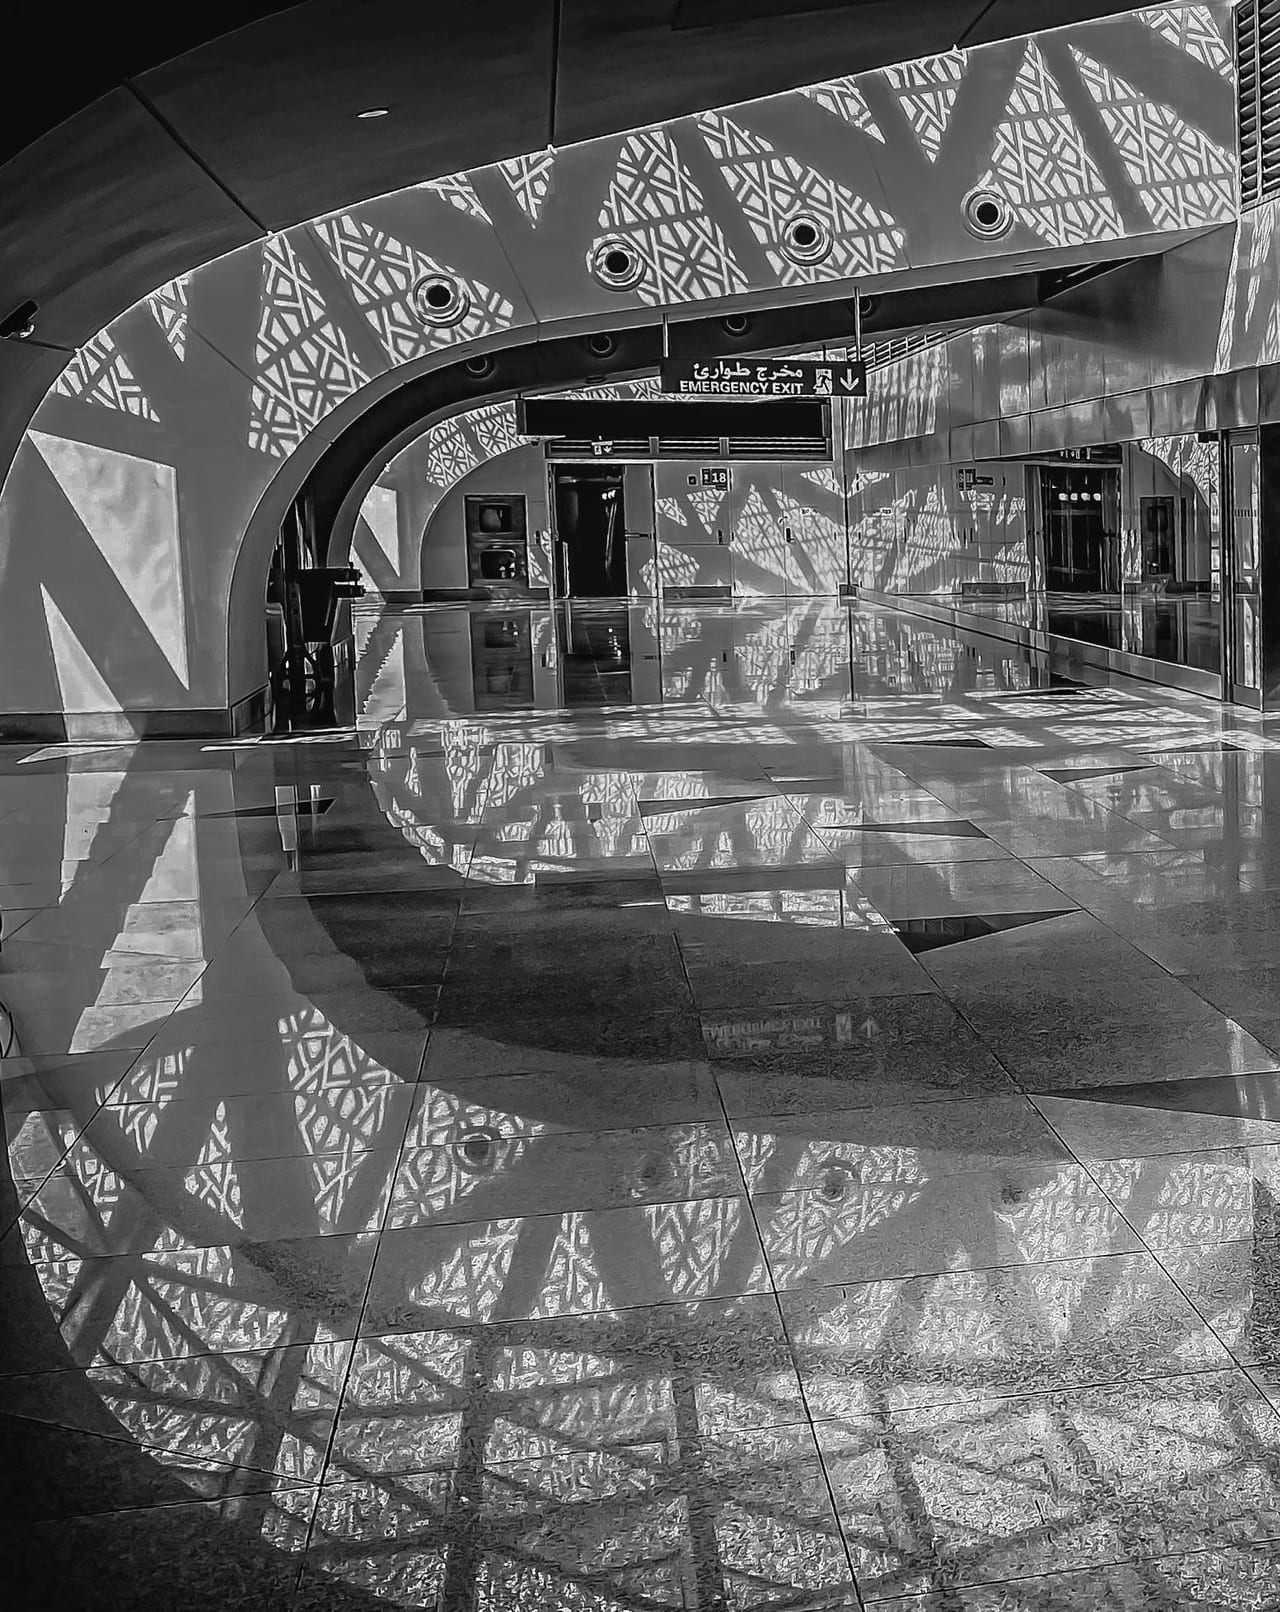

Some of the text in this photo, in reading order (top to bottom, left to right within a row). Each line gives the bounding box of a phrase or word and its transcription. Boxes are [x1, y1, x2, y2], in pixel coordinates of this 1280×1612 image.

[756, 364, 803, 381] مخرج
[680, 380, 804, 395] EMERGENCY EXIT
[711, 472, 727, 483] 18
